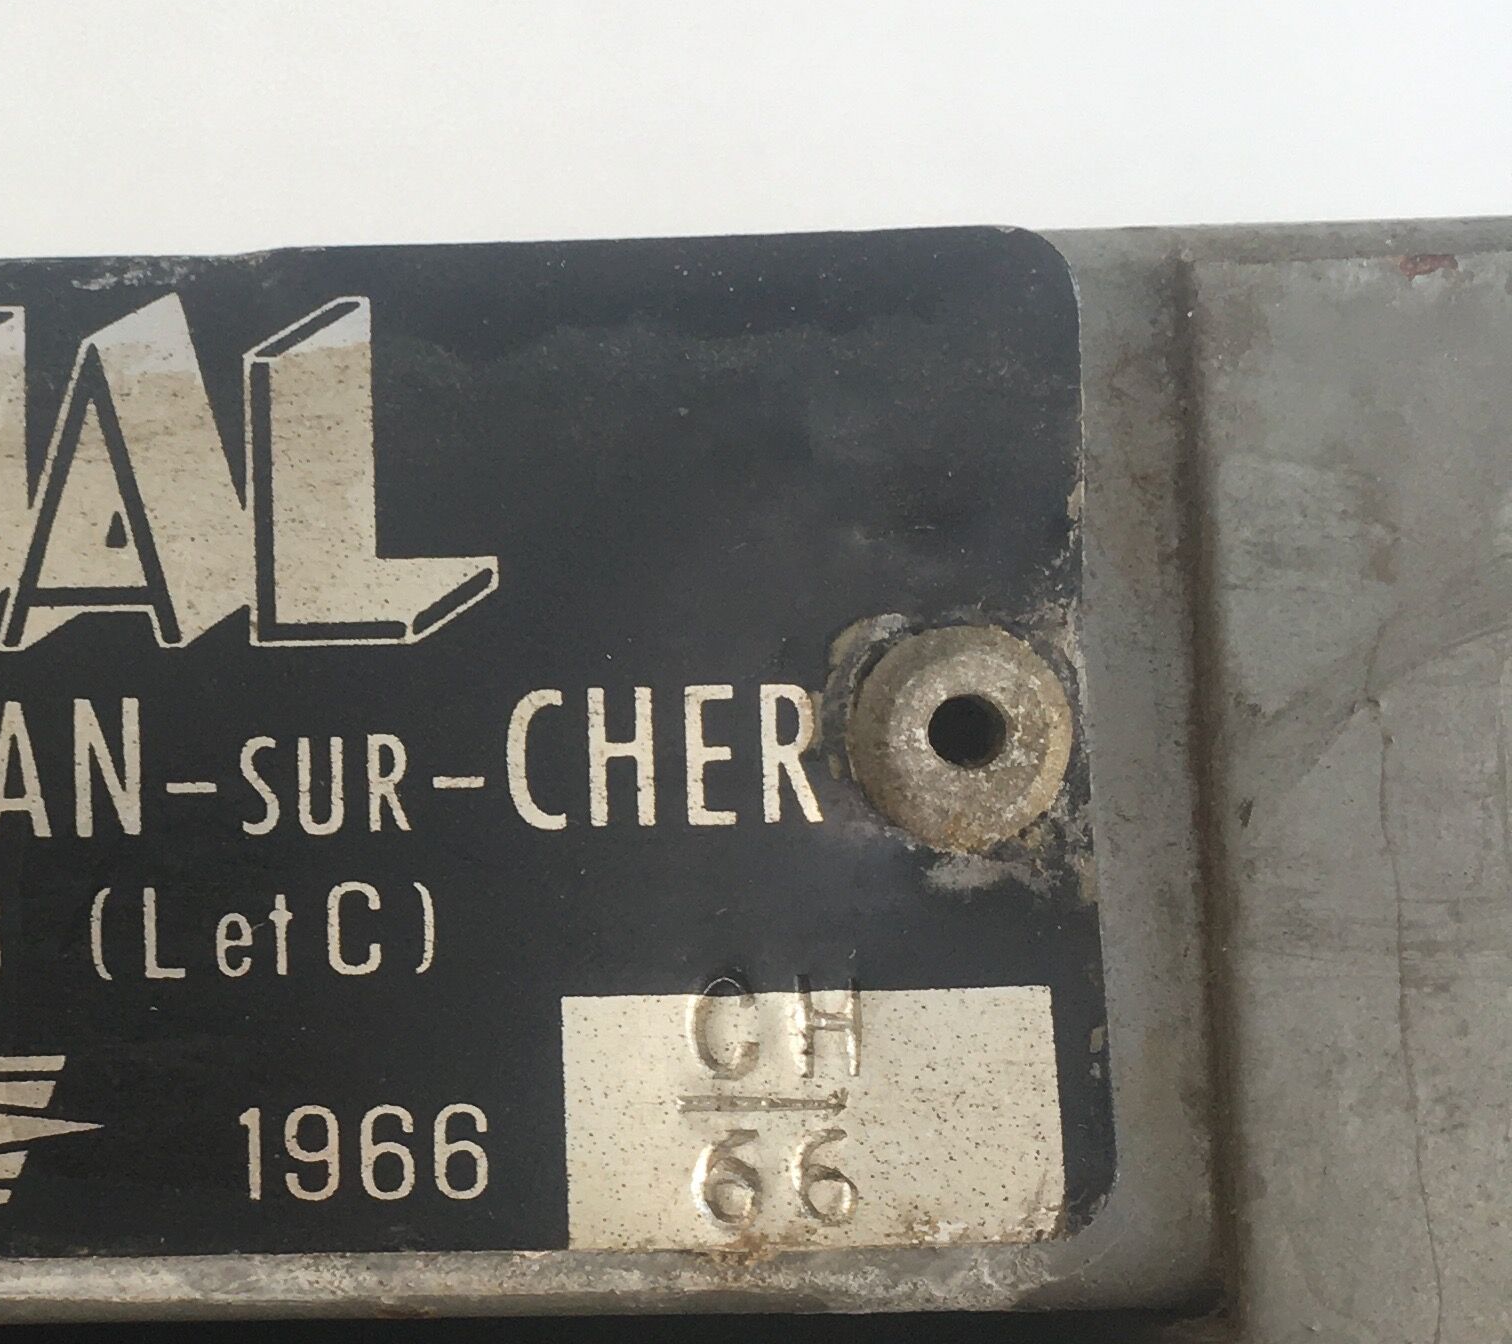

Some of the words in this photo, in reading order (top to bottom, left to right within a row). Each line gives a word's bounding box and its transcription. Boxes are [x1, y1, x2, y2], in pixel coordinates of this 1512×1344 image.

[686, 974, 862, 1080] CH
[238, 1102, 490, 1202] 1966
[689, 1128, 859, 1230] 66
